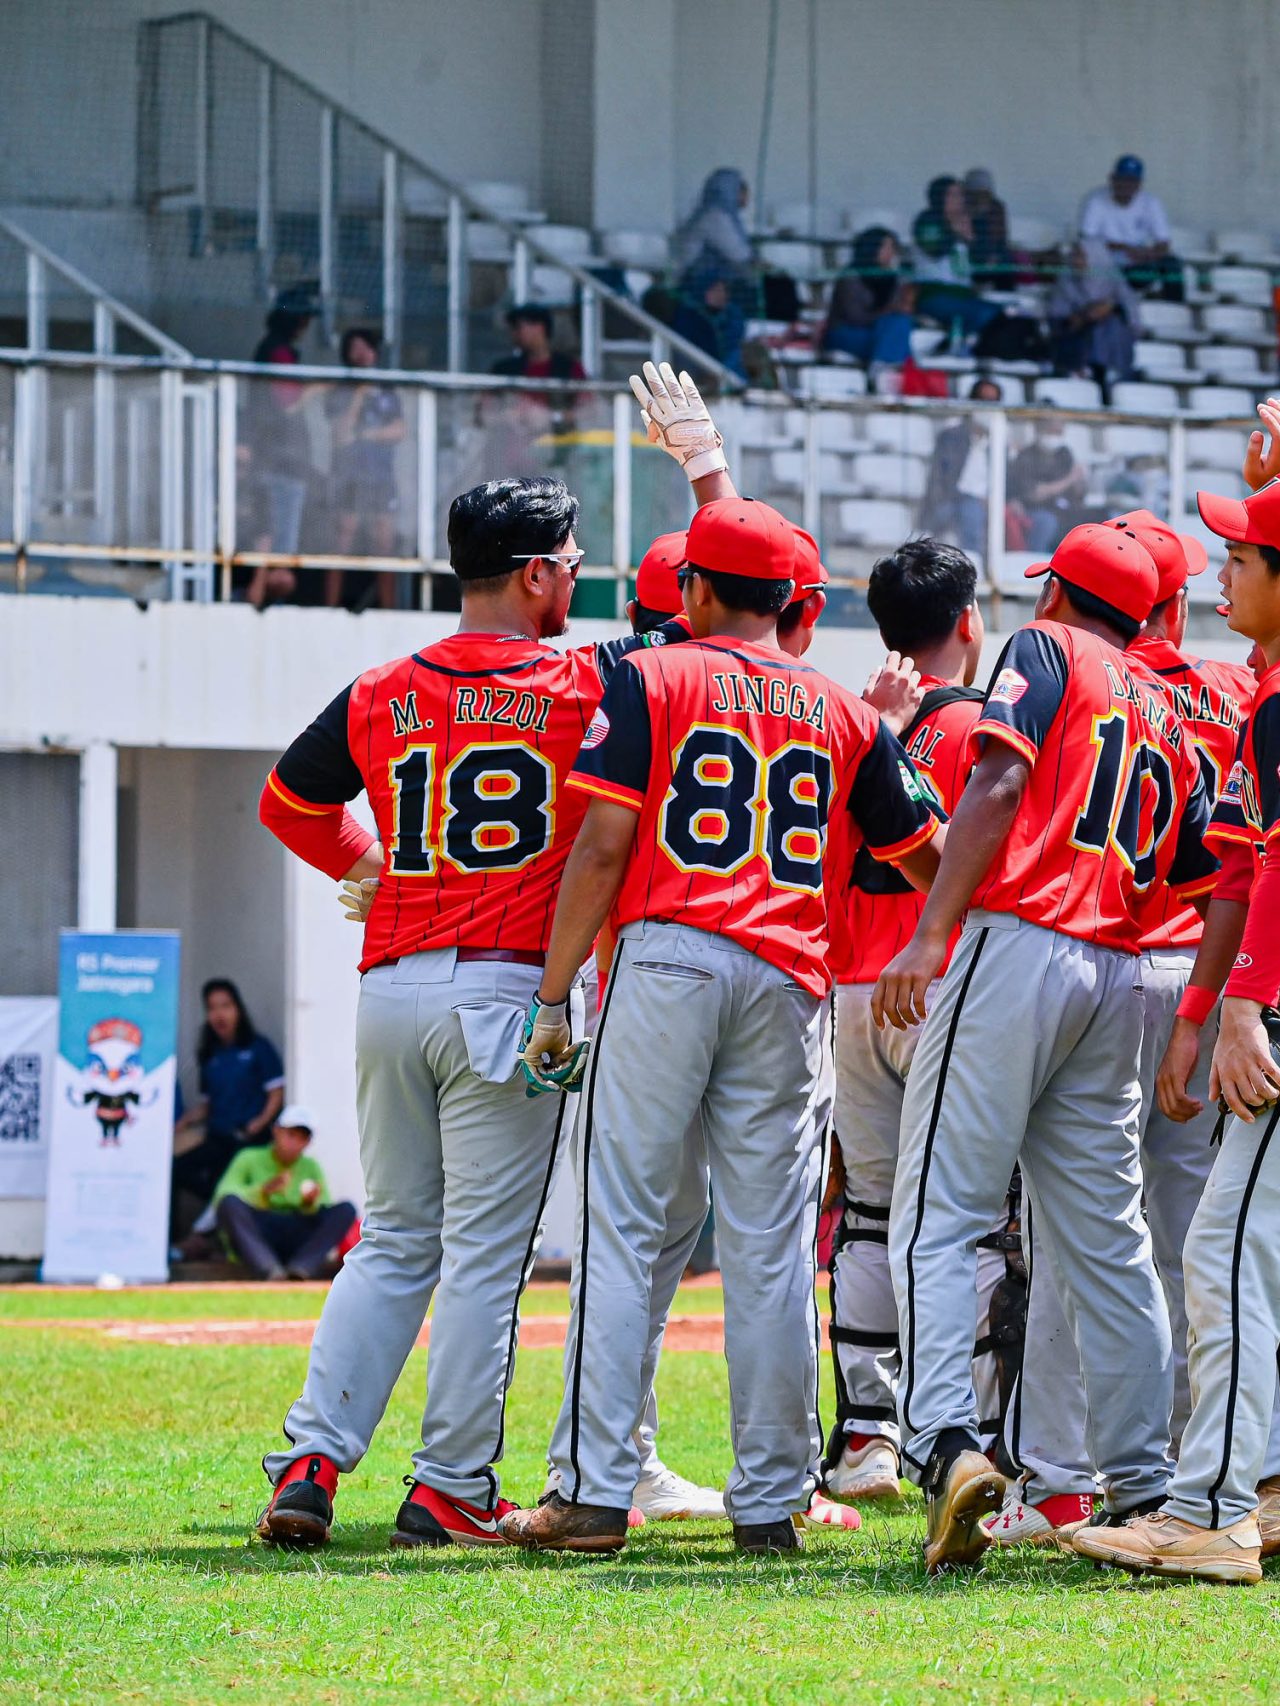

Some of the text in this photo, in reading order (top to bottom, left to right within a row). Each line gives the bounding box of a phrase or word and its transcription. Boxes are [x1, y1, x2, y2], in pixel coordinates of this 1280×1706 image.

[388, 685, 554, 738] M. RIZQI
[711, 672, 827, 733] JINGGA
[387, 740, 556, 877] 18
[657, 721, 837, 897] 88
[1067, 705, 1178, 894] 10
